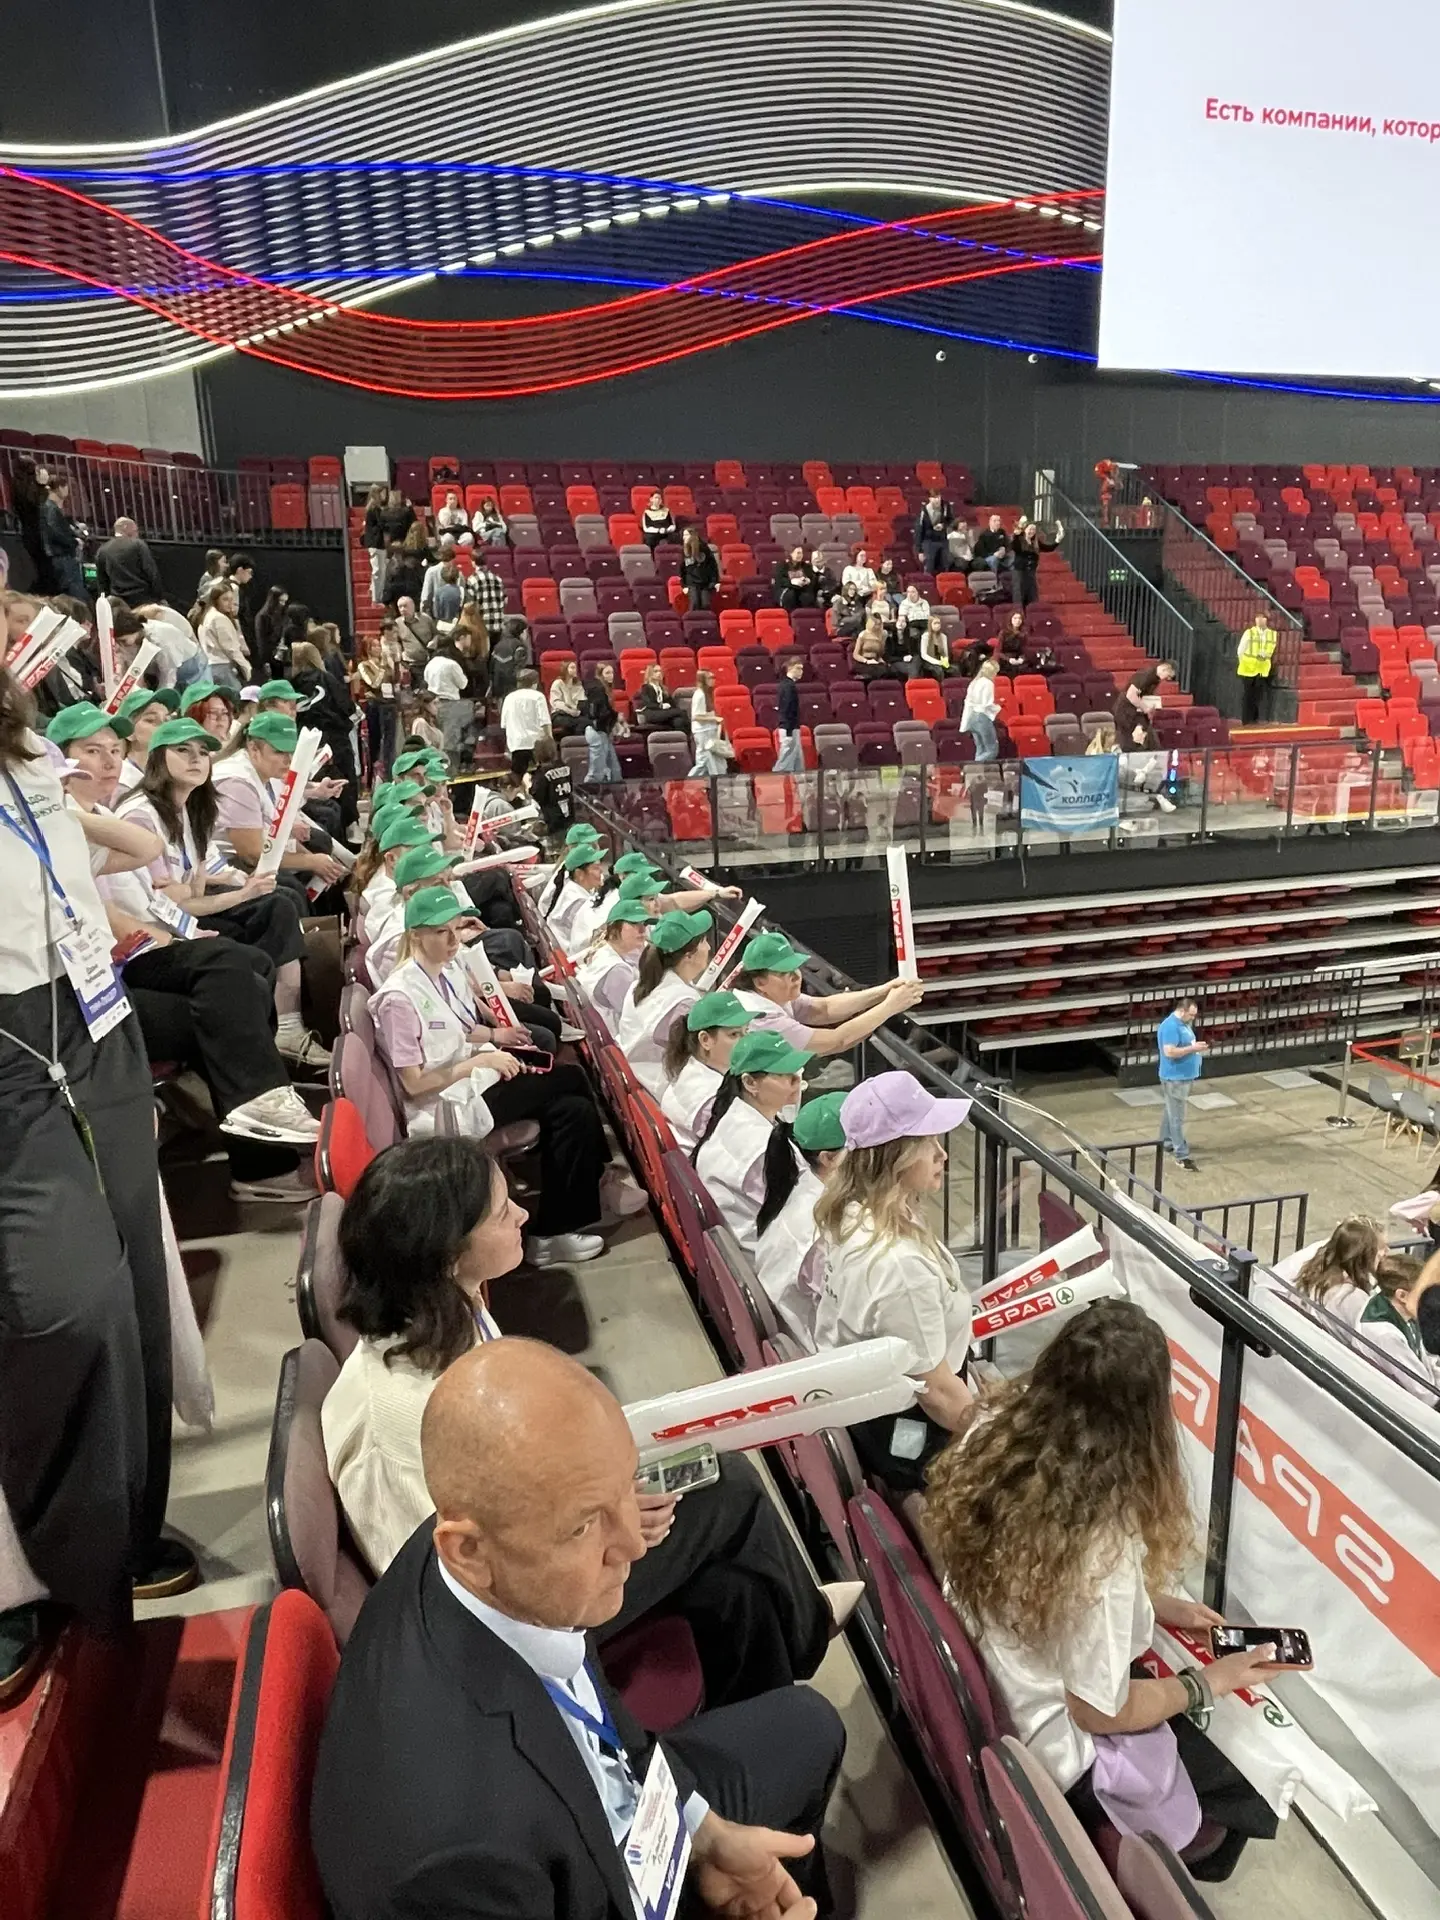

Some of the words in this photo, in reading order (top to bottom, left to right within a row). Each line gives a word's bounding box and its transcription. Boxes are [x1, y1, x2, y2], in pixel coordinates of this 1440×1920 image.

[1205, 97, 1254, 122] Есть
[1262, 107, 1376, 137] компании,
[984, 1270, 1045, 1309] SPAR
[987, 1295, 1054, 1329] SPAR
